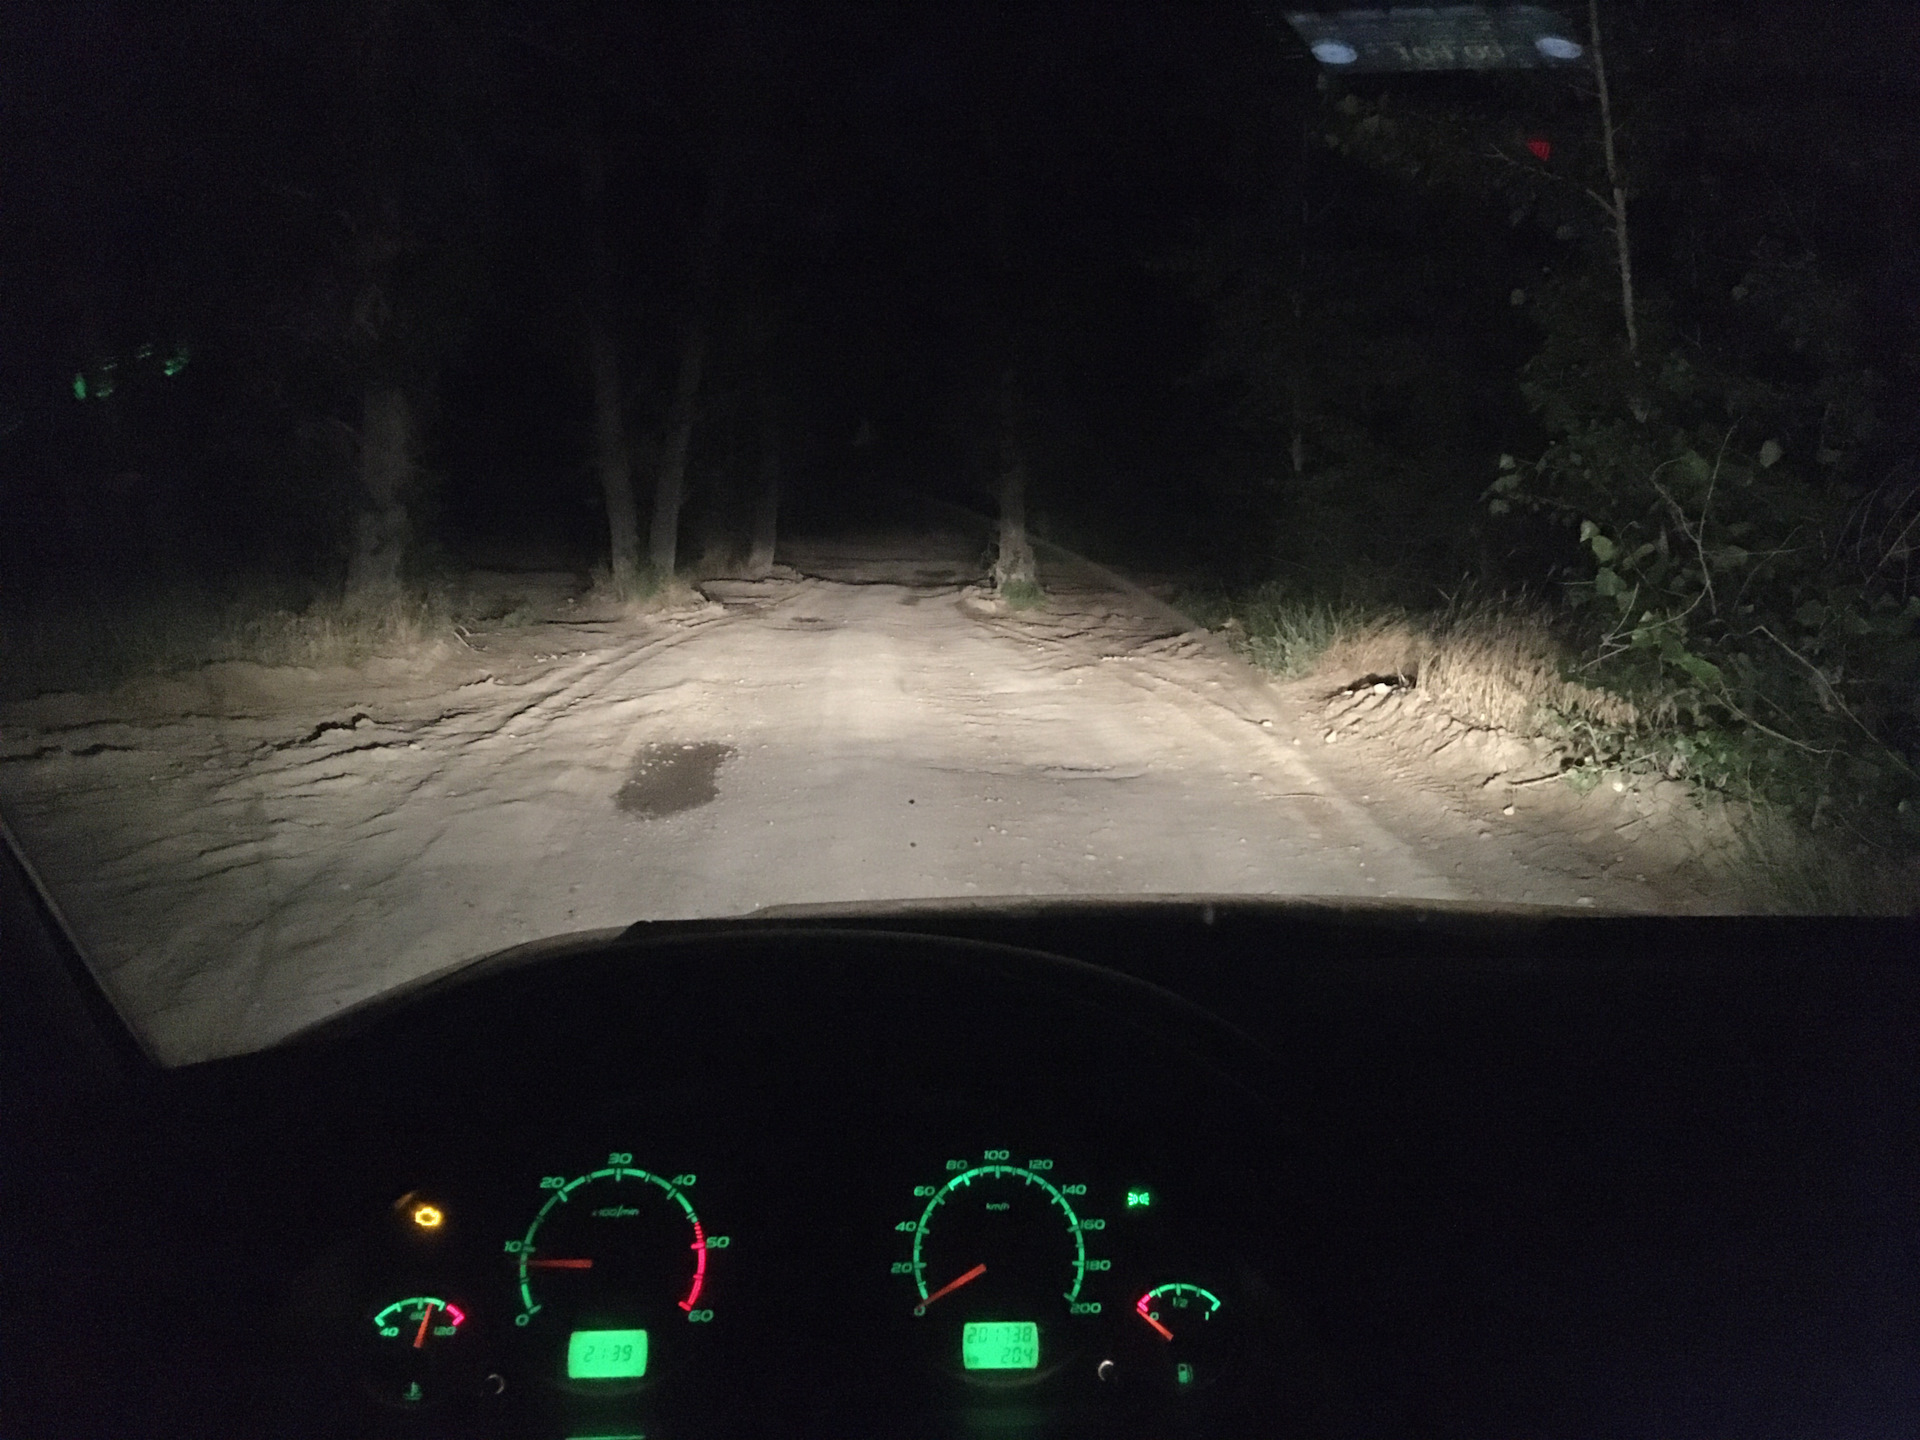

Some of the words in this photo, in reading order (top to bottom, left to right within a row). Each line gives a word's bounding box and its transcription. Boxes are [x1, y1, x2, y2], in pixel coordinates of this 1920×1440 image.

[608, 1153, 633, 1164] 30
[984, 1150, 1009, 1160] 100
[946, 1160, 968, 1170] 80
[1029, 1159, 1053, 1170] 120
[540, 1176, 565, 1188] 20
[672, 1174, 696, 1186] 40
[914, 1186, 935, 1196] 60
[1062, 1184, 1087, 1195] 140
[986, 1202, 1010, 1211] km/h
[895, 1221, 917, 1232] 40
[1080, 1219, 1106, 1230] 160
[504, 1241, 522, 1252] 10
[706, 1236, 730, 1249] 50
[891, 1262, 913, 1273] 20
[1086, 1260, 1111, 1271] 180
[1070, 1302, 1101, 1314] 200
[515, 1313, 529, 1326] 0
[688, 1309, 714, 1322] 60
[379, 1326, 400, 1337] 40
[433, 1326, 457, 1336] 120
